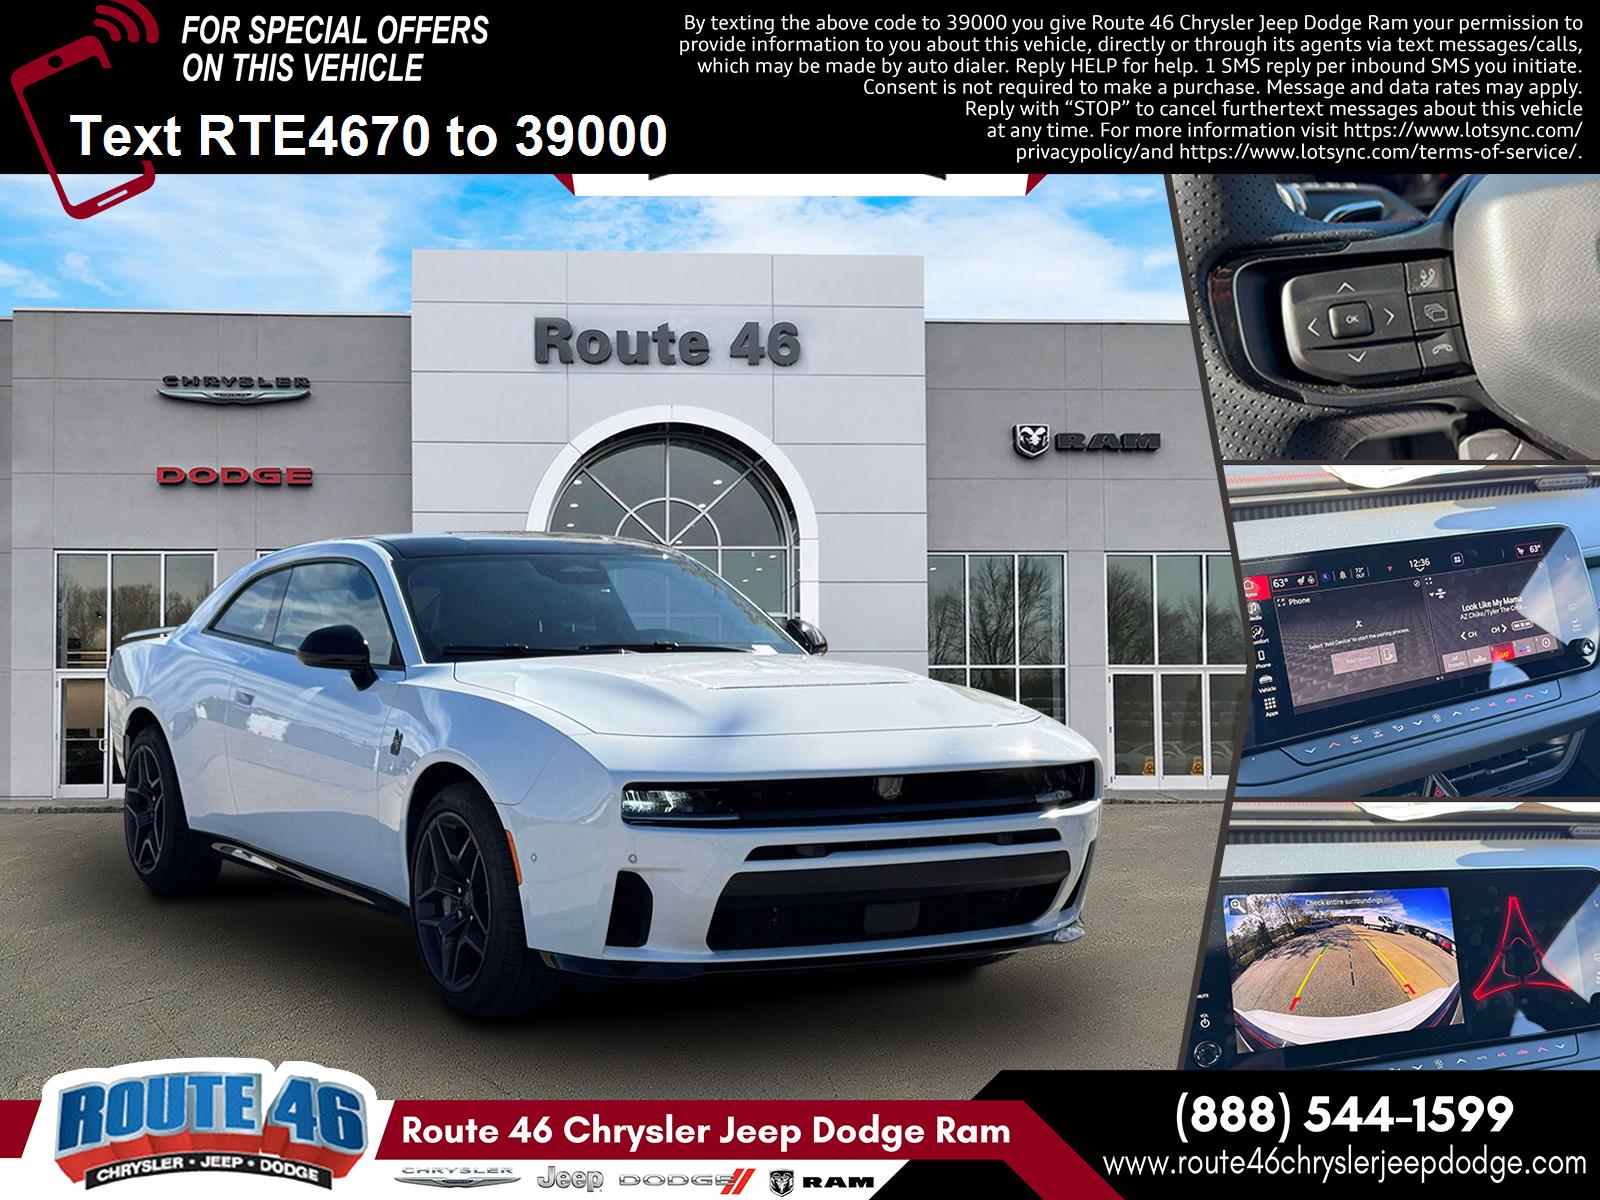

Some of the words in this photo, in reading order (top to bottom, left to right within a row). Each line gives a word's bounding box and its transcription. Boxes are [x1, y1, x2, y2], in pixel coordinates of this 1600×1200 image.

[1345, 315, 1360, 324] OK
[534, 317, 710, 366] Route
[729, 321, 801, 367] 46
[162, 375, 310, 388] CHRYSLER
[1054, 432, 1161, 452] RAM
[156, 466, 313, 487] DODGE
[1409, 557, 1431, 568] 12:36
[1272, 577, 1289, 588] 63°
[1288, 597, 1311, 606] Phone
[1461, 603, 1478, 612] Look
[1478, 600, 1492, 609] Like
[1492, 598, 1503, 607] My
[1502, 595, 1523, 604] Mama
[1499, 606, 1510, 614] The
